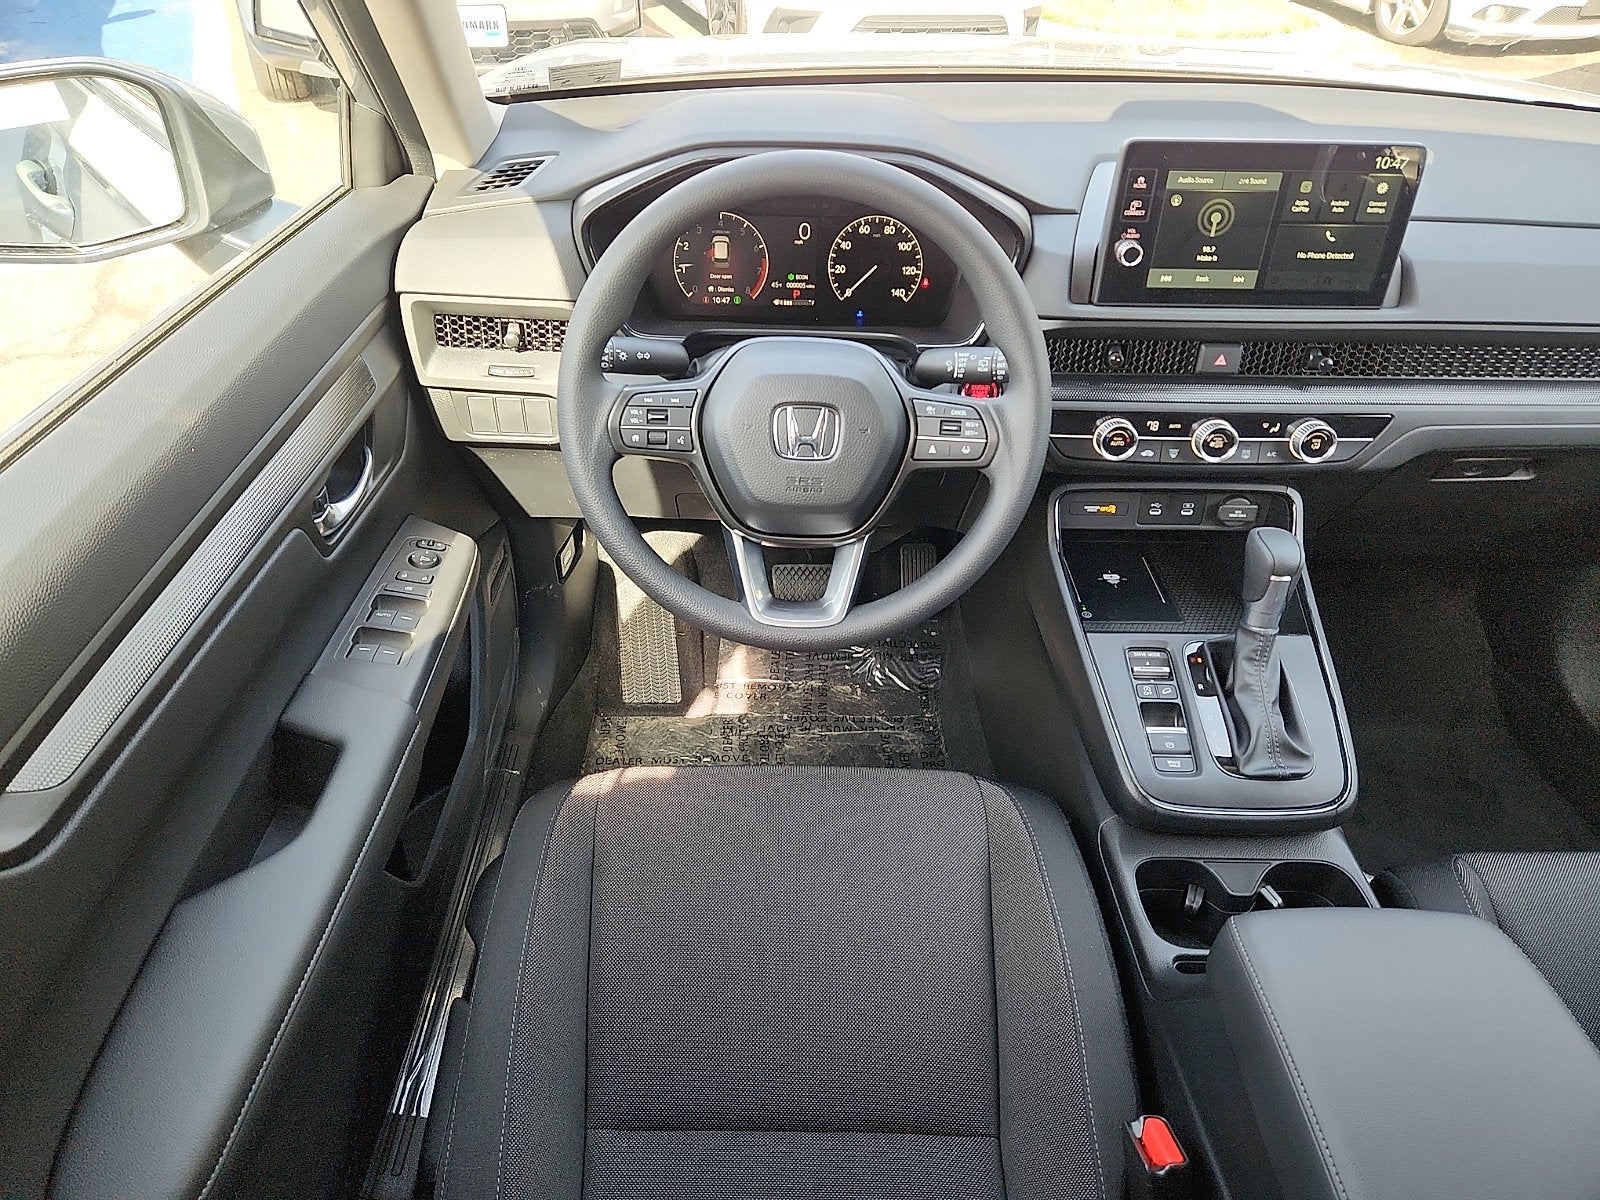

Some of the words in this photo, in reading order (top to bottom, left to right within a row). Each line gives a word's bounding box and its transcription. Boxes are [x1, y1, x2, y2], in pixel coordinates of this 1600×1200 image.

[1375, 156, 1410, 170] 10:47
[798, 222, 811, 240] 0
[858, 225, 871, 235] 60
[883, 225, 896, 235] 80
[683, 241, 689, 251] 2
[839, 240, 852, 250] 40
[897, 241, 913, 251] 100
[1326, 252, 1355, 260] Detected
[901, 266, 917, 276] 120
[793, 289, 801, 299] P
[890, 288, 906, 298] 140
[712, 296, 731, 304] 10:47
[595, 757, 643, 766] DEALER
